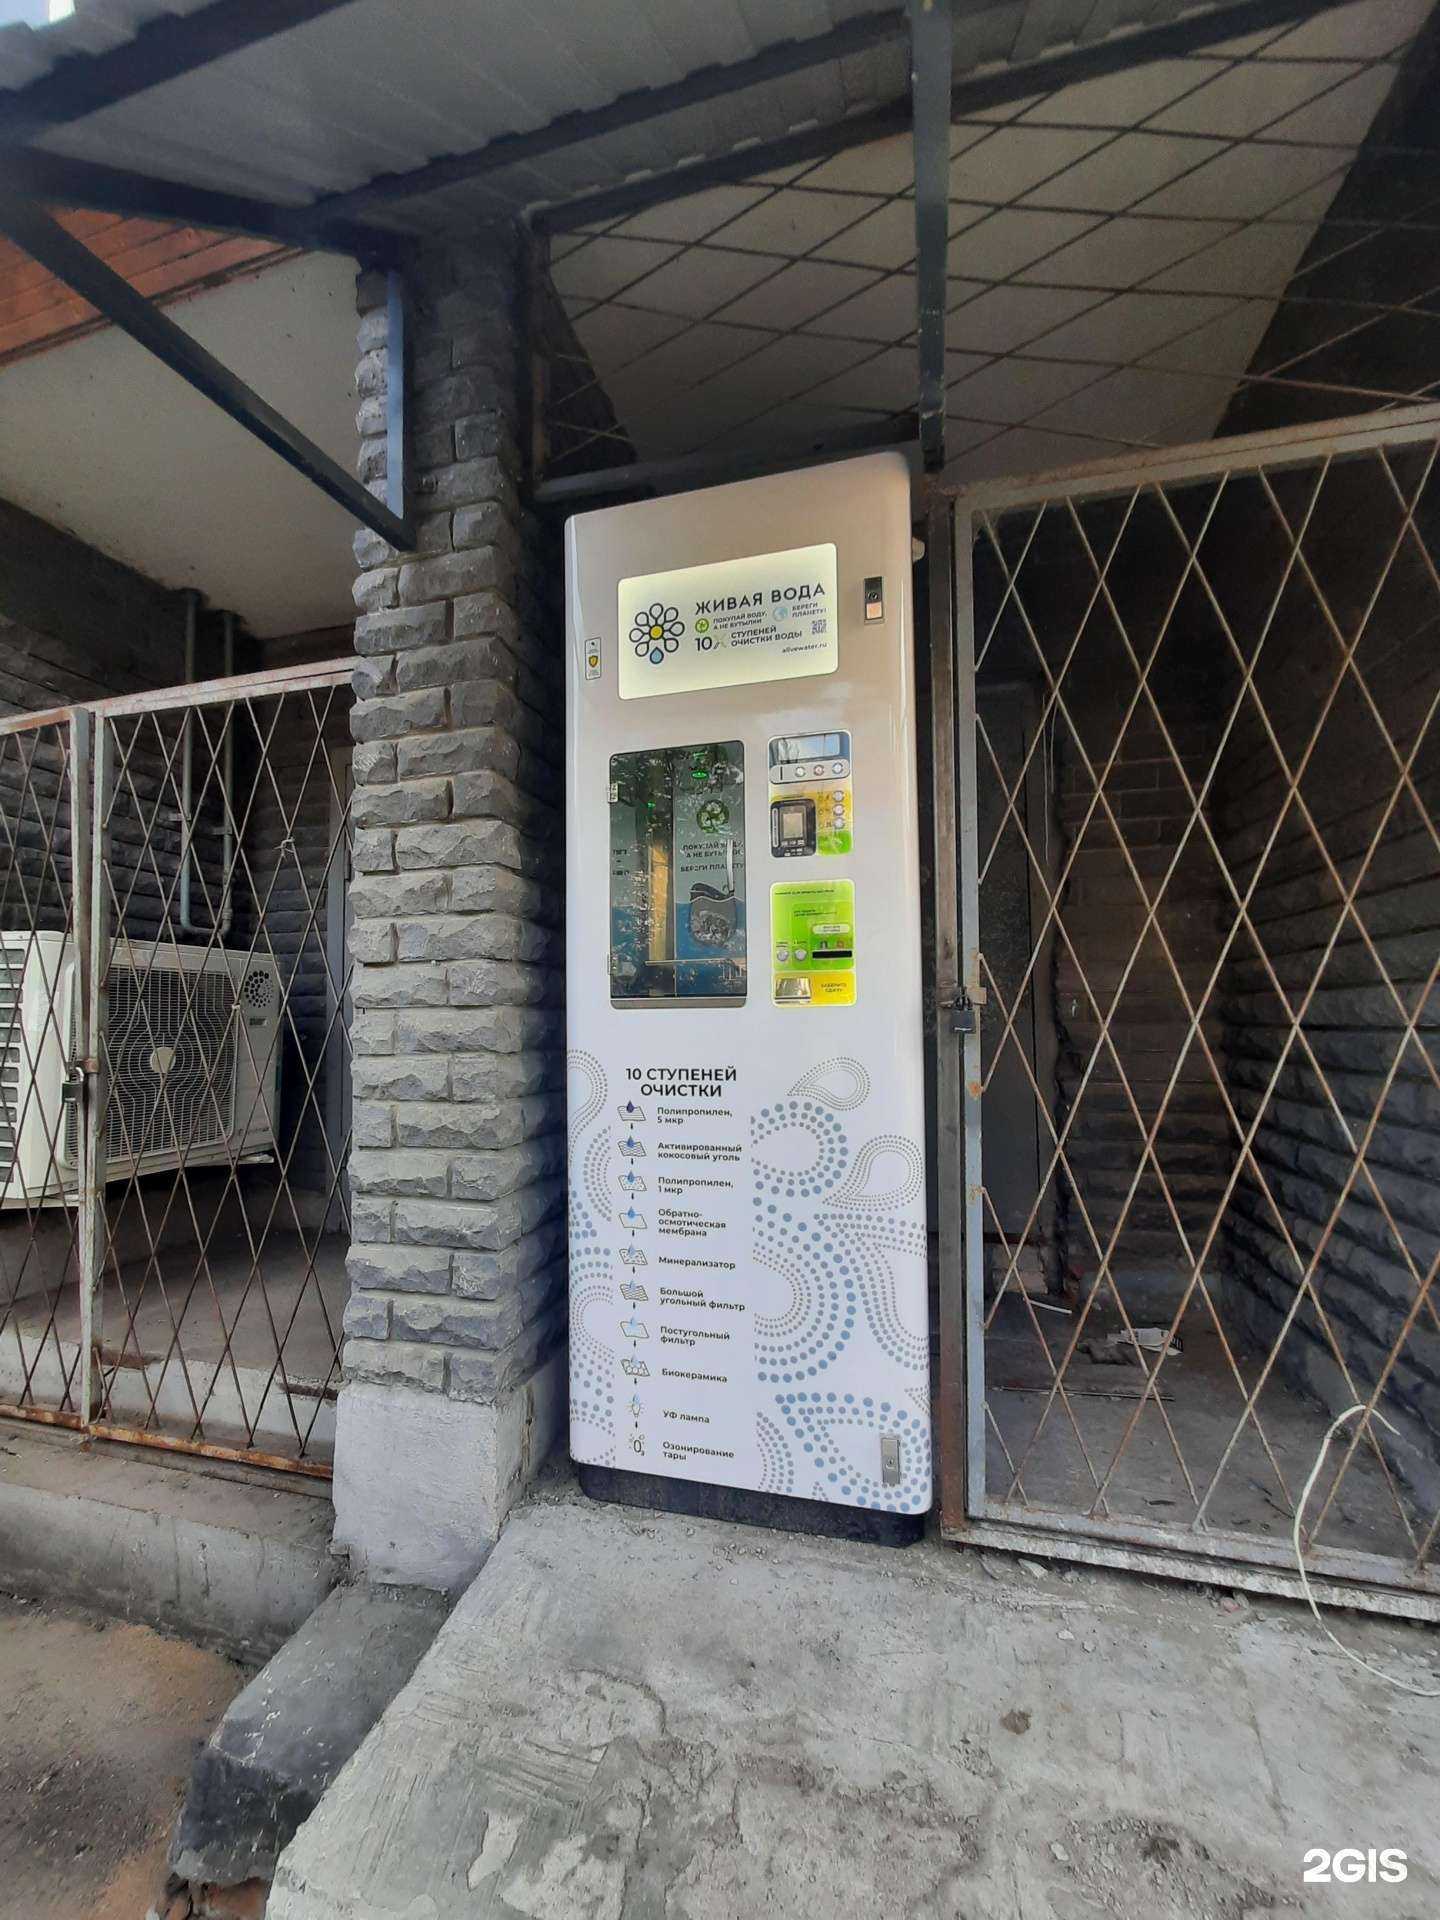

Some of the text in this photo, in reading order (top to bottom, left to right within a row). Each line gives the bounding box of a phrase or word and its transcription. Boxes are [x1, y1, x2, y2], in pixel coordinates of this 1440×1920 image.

[696, 583, 824, 615] ЖИВАЯ ВОДА
[695, 625, 777, 651] 10 СТУПЕНЕЙ
[731, 631, 802, 646] ОЧИСТКИ ВОДЫ
[626, 1066, 736, 1081] 10 СТУПЕНЕЙ
[641, 1084, 722, 1097] ОЧИСТКИ
[657, 1107, 733, 1117] Полипропилен,
[658, 1142, 742, 1152] Активированный
[658, 1152, 710, 1160] кокосовый
[658, 1177, 734, 1188] Полипропилен,
[664, 1187, 683, 1195] мкр
[658, 1208, 702, 1218] Обратно-
[658, 1219, 726, 1228] осмотическая
[658, 1227, 707, 1237] мембрана
[658, 1256, 736, 1270] Минерализатор
[660, 1287, 704, 1298] Большой
[660, 1297, 745, 1311] угольный фильтр
[660, 1326, 730, 1340] Постугольный
[660, 1336, 696, 1346] фильтр
[662, 1368, 728, 1383] Биокерамика
[680, 1414, 710, 1423] лампа
[662, 1441, 734, 1458] Озонирование
[662, 1451, 686, 1460] тары
